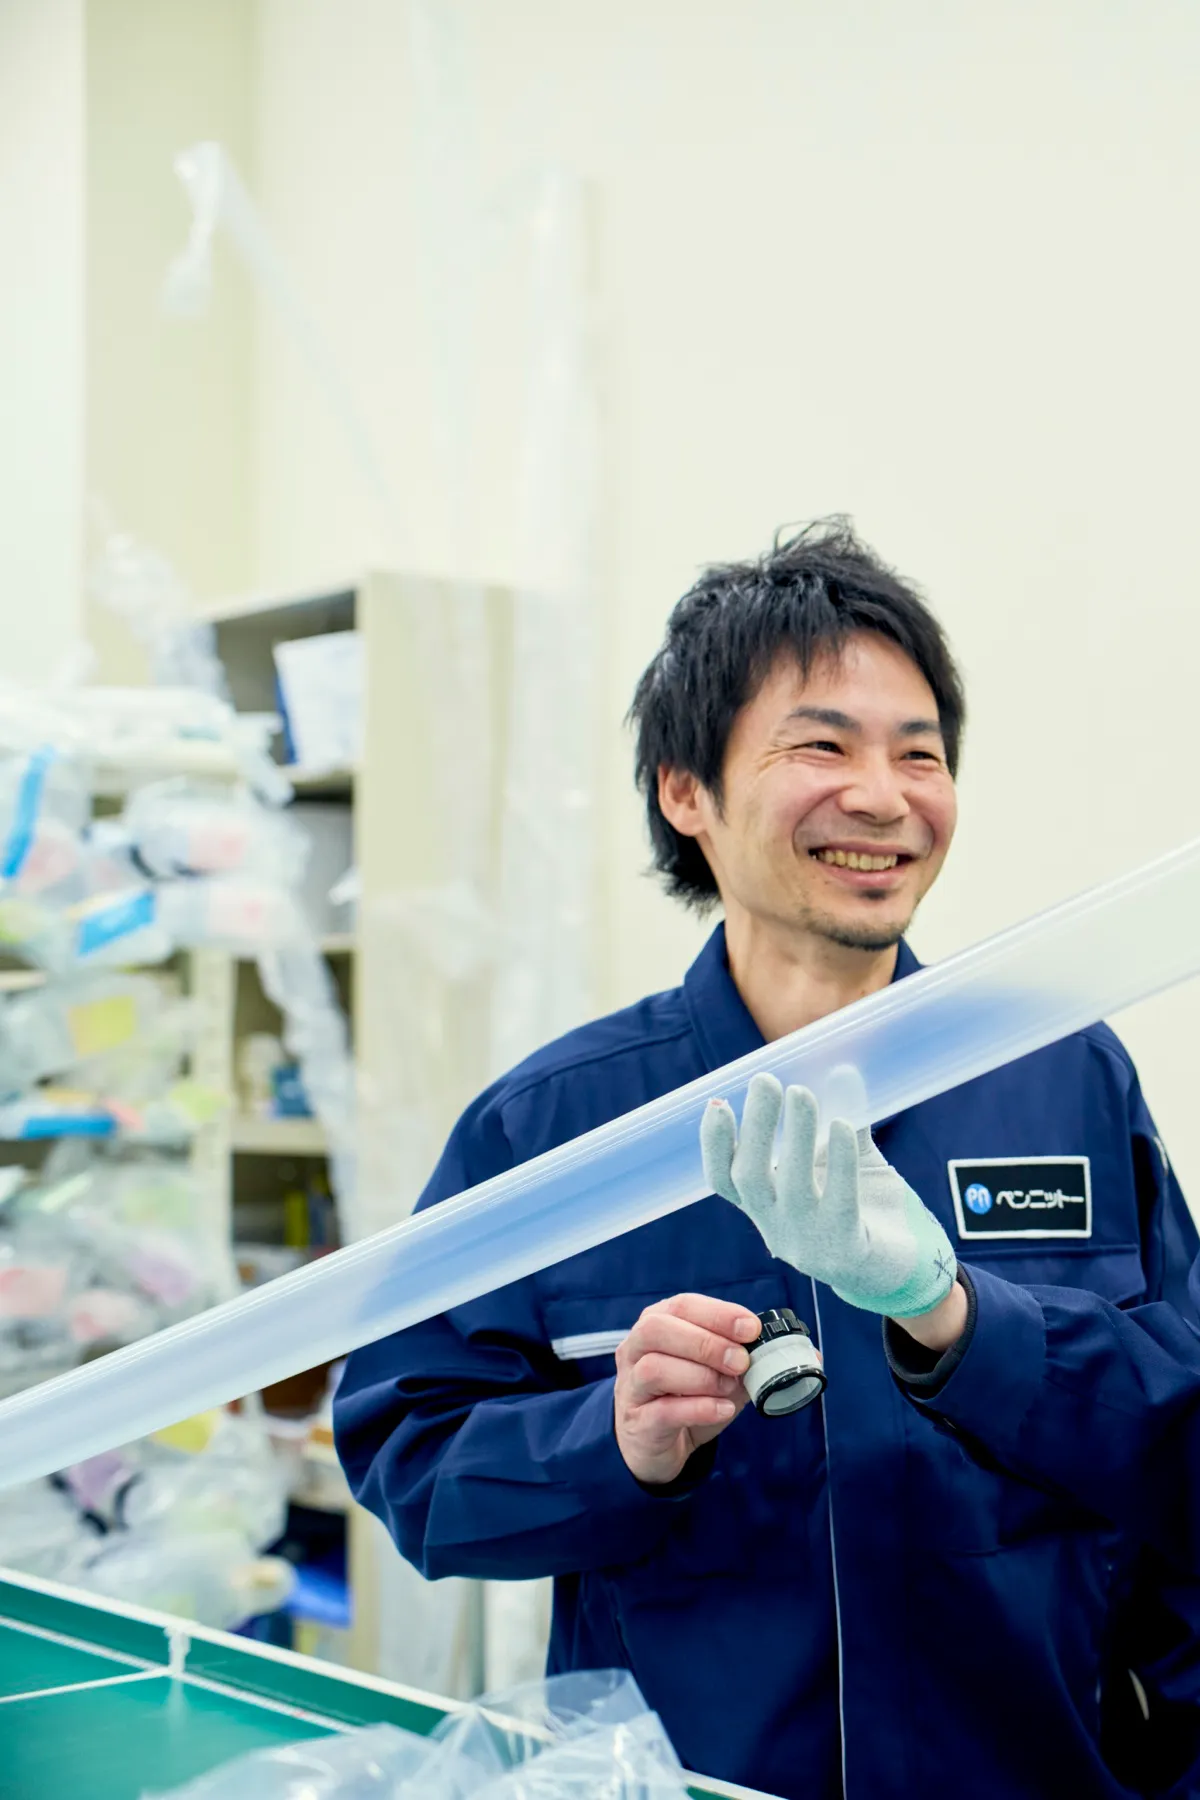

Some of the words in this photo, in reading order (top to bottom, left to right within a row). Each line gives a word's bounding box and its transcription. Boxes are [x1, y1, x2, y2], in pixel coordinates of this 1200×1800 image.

[996, 1188, 1085, 1209] ペンニット
